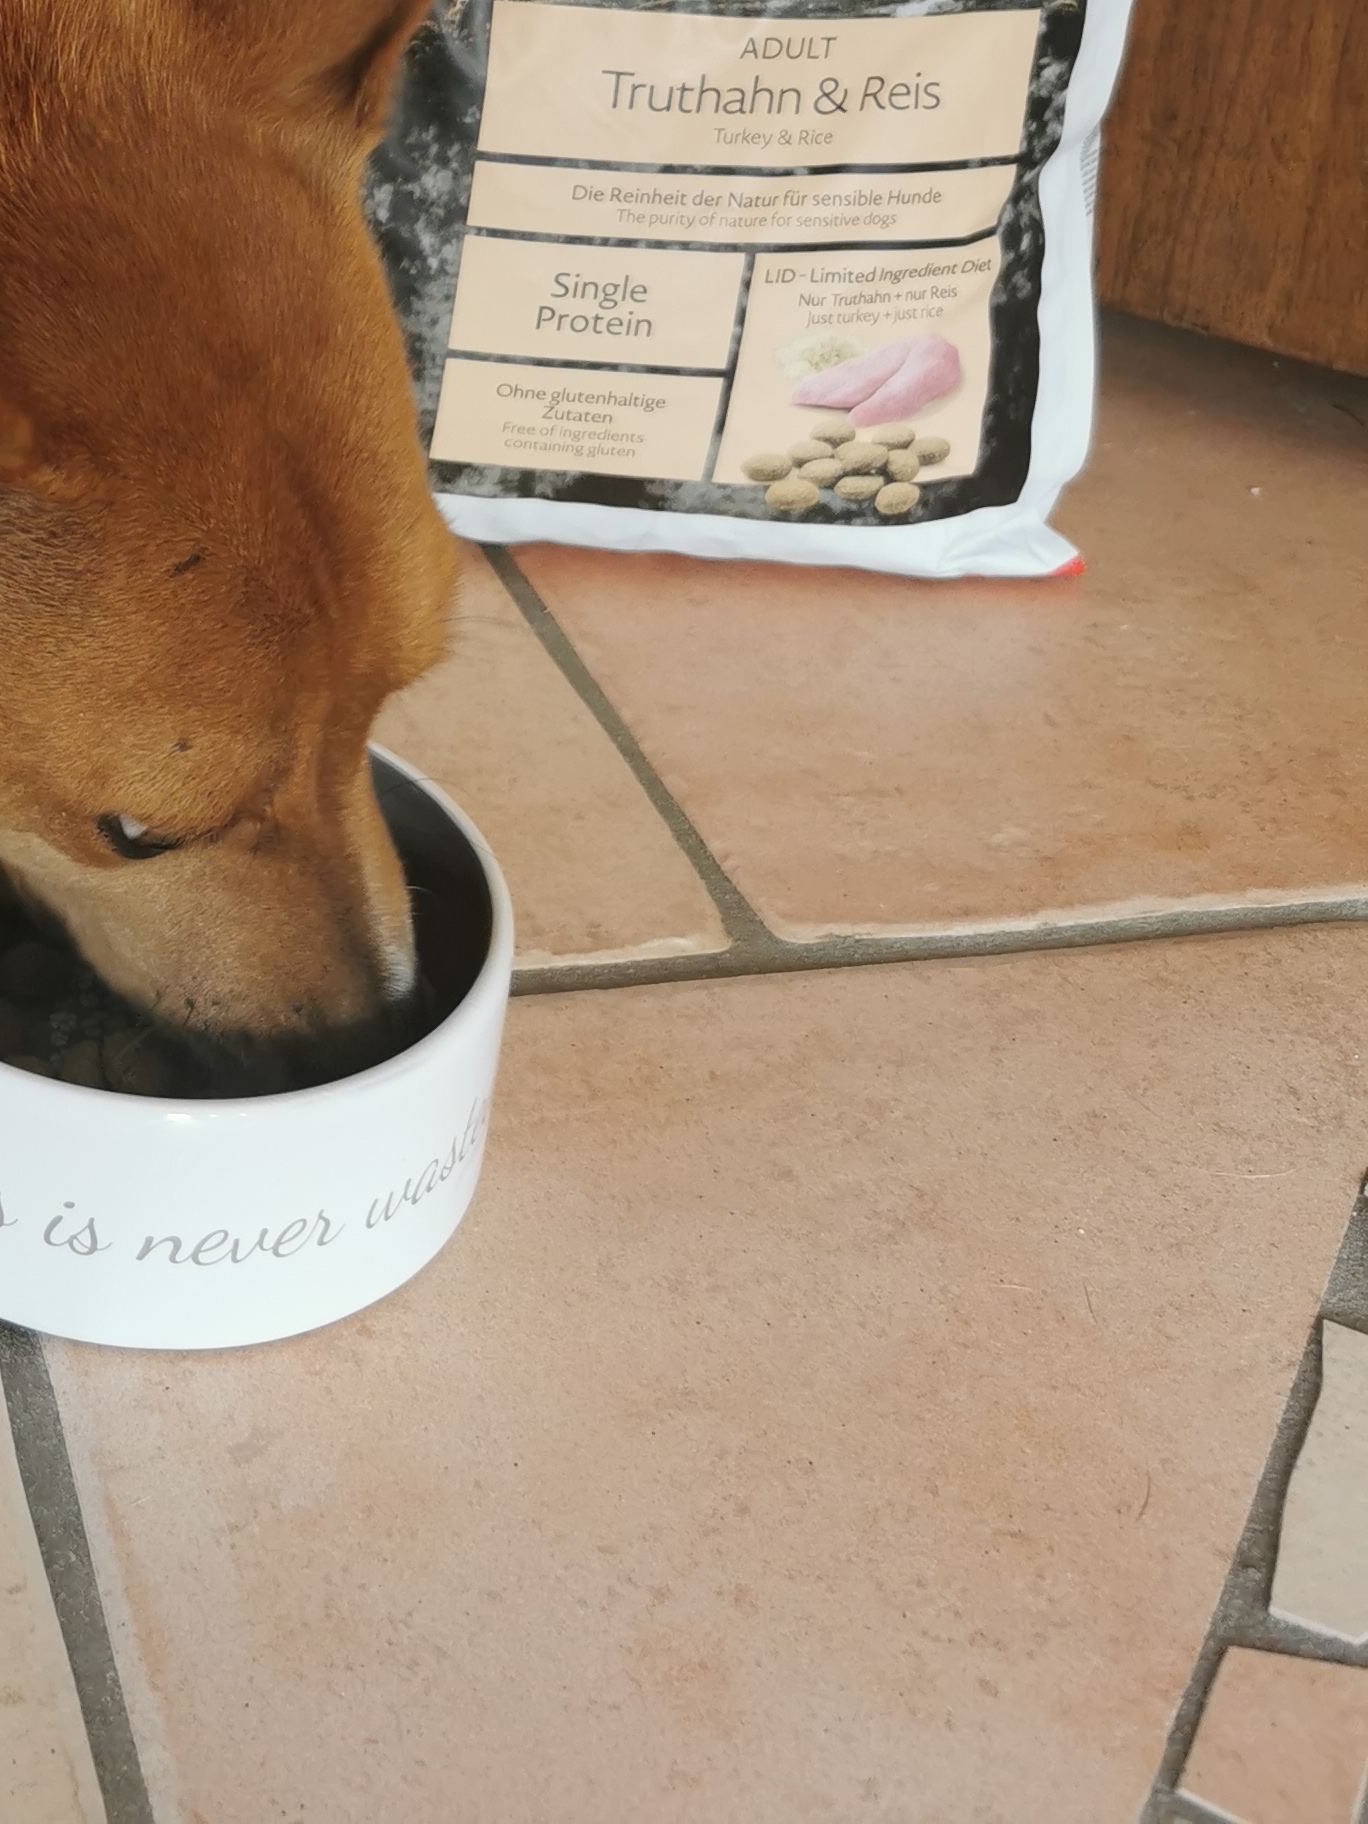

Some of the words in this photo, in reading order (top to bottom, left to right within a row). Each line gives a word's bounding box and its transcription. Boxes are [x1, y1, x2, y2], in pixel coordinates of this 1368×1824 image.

[739, 36, 839, 61] ADULT
[601, 69, 802, 116] Truthahn
[812, 76, 849, 116] &
[859, 71, 942, 113] Reis
[713, 127, 774, 150] Turkey
[777, 129, 793, 146] &
[798, 129, 834, 146] Rice
[571, 184, 605, 203] Die
[609, 186, 688, 208] Reinheit
[692, 190, 724, 208] der
[727, 190, 779, 209] Natur
[782, 189, 809, 208] für
[811, 189, 883, 208] sensible
[886, 186, 943, 206] Hunde
[616, 208, 646, 225] The
[648, 210, 696, 229] purity
[698, 211, 717, 227] of
[719, 213, 768, 228] nature
[770, 211, 793, 228] for
[795, 212, 861, 228] sensitive
[863, 211, 898, 229] dogs
[764, 267, 797, 284] LID
[809, 266, 876, 284] Limited
[878, 262, 958, 285] Ingredient
[960, 258, 992, 274] Diet
[549, 271, 650, 311] Single
[797, 293, 827, 307] Nur
[831, 289, 891, 307] Truthahn
[905, 288, 927, 302] nur
[930, 285, 958, 300] Reis
[535, 304, 654, 339] Protein
[805, 310, 833, 328] Just
[836, 308, 880, 326] turkey
[920, 304, 944, 319] rice
[496, 383, 547, 401] Ohne
[549, 387, 667, 413] glutenhaltige
[541, 405, 614, 425] Zutaten
[502, 421, 536, 436] Free
[539, 424, 555, 437] of
[559, 426, 644, 444] ingredients
[504, 438, 584, 457] containing
[586, 443, 636, 458] gluten
[42, 1200, 113, 1257] is
[135, 1206, 345, 1267] never
